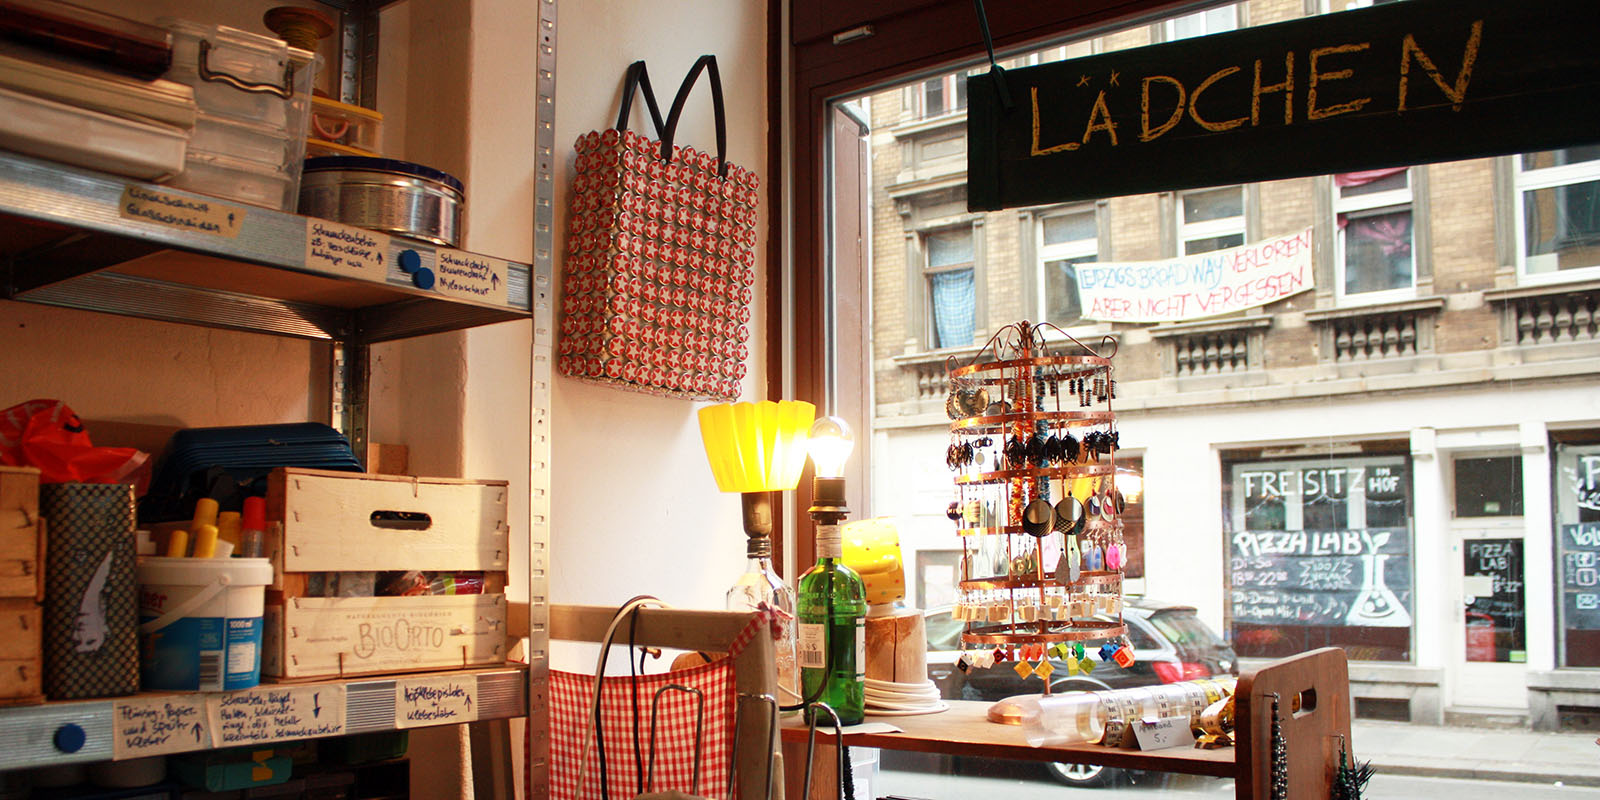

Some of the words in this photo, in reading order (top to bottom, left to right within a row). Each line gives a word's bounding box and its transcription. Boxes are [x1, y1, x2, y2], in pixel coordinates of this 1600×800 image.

[1031, 20, 1483, 157] LÄDCHEN
[1079, 267, 1137, 290] LEIPZIGS
[1136, 256, 1225, 290] BROADWAY
[1226, 228, 1312, 273] VERLOREN
[1090, 296, 1134, 319] ABER
[1137, 293, 1192, 318] NICHT
[1195, 265, 1304, 313] VERGESSEN
[1240, 468, 1366, 498] FREISITZ
[1368, 476, 1401, 493] HOF
[1232, 530, 1308, 558] PIZZA
[1470, 543, 1515, 559] PIZZA
[1480, 557, 1508, 571] LAB
